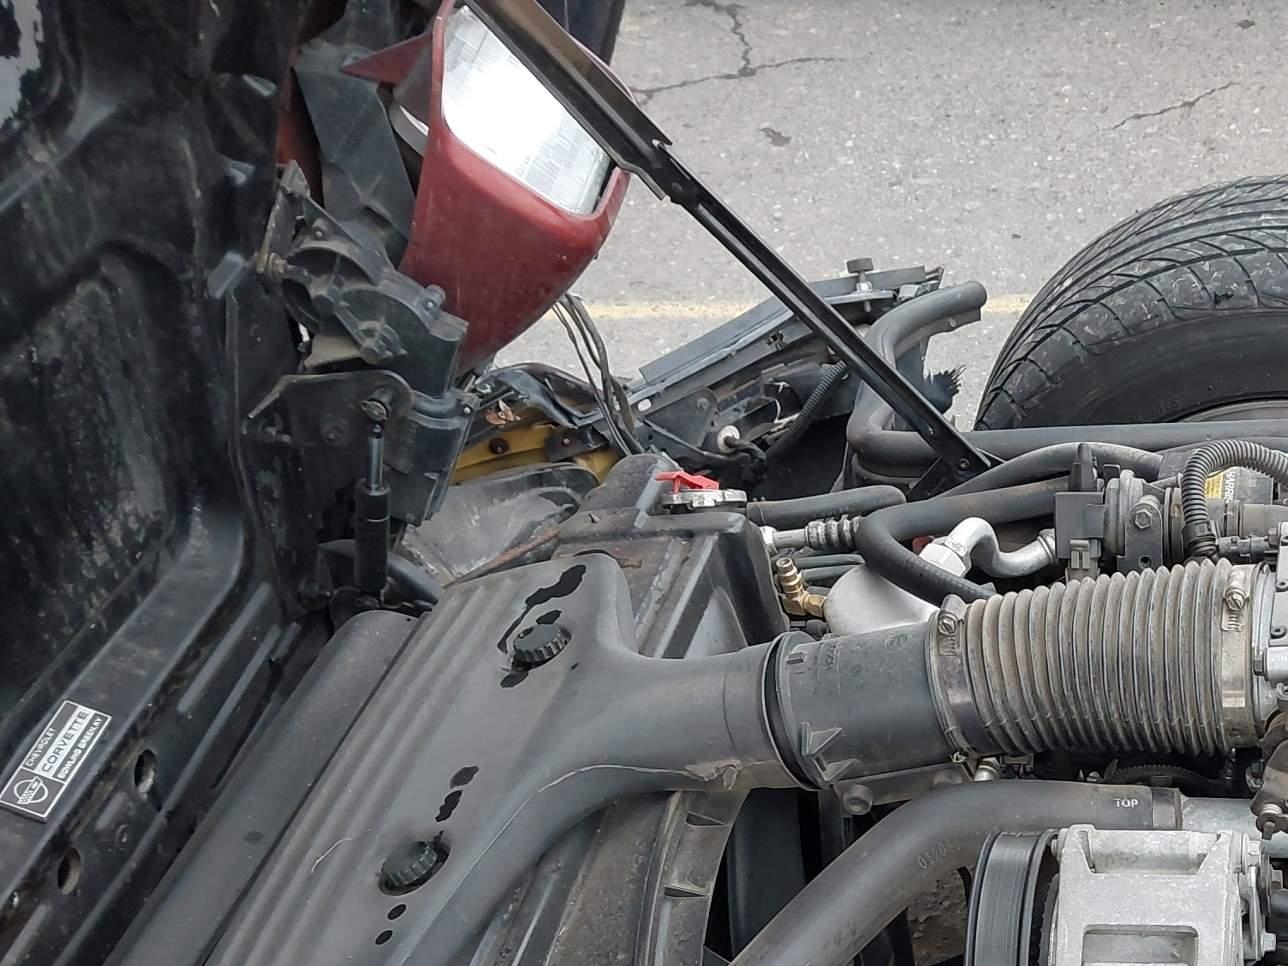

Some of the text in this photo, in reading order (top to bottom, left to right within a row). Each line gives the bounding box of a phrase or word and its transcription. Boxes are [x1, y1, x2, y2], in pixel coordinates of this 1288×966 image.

[25, 727, 56, 767] CHEVROLET
[41, 710, 89, 773] CORVETTE
[57, 748, 82, 779] BOWLING
[1114, 798, 1139, 809] TOP
